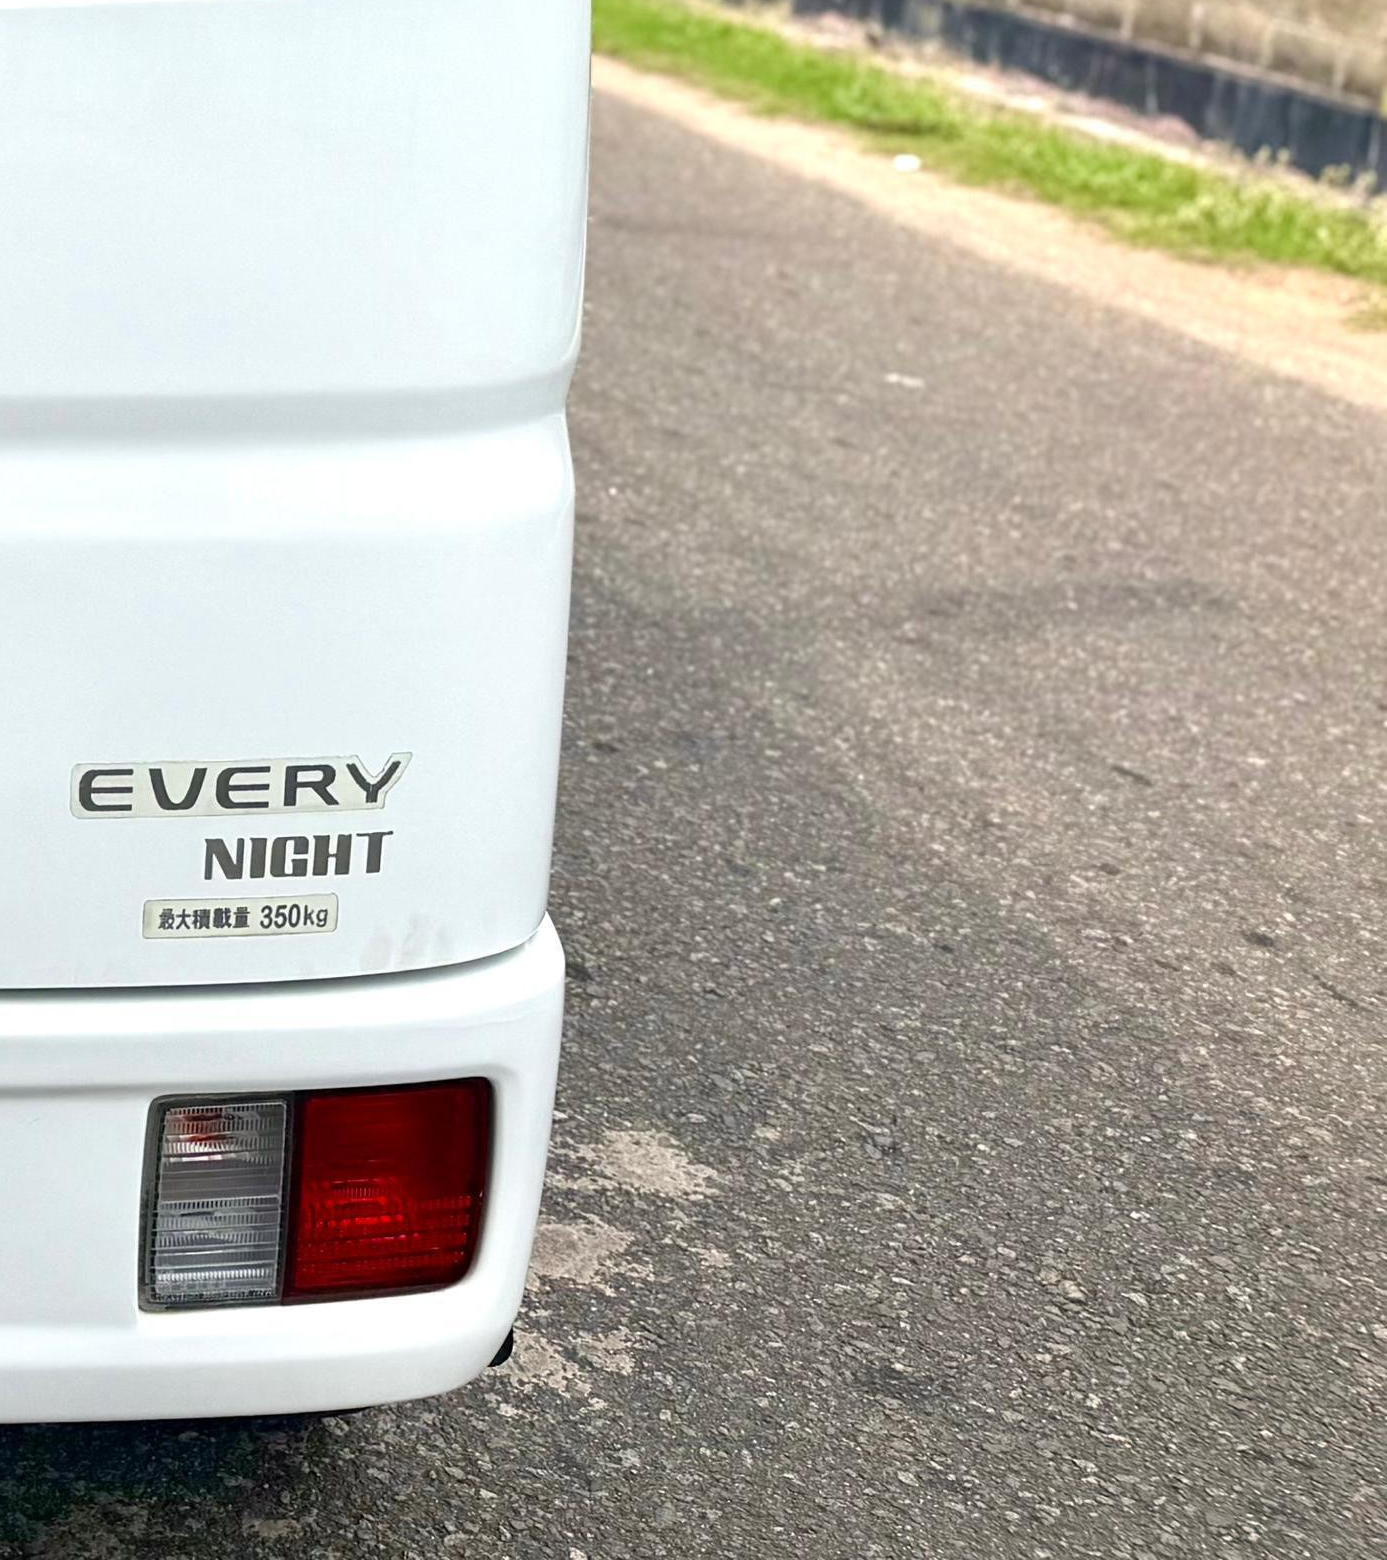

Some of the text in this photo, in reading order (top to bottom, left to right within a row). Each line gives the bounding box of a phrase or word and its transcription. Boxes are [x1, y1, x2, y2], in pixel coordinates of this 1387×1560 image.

[78, 761, 401, 811] EVERY
[203, 830, 394, 880] NIGHT
[158, 904, 329, 930] 最大積載量 350kg
